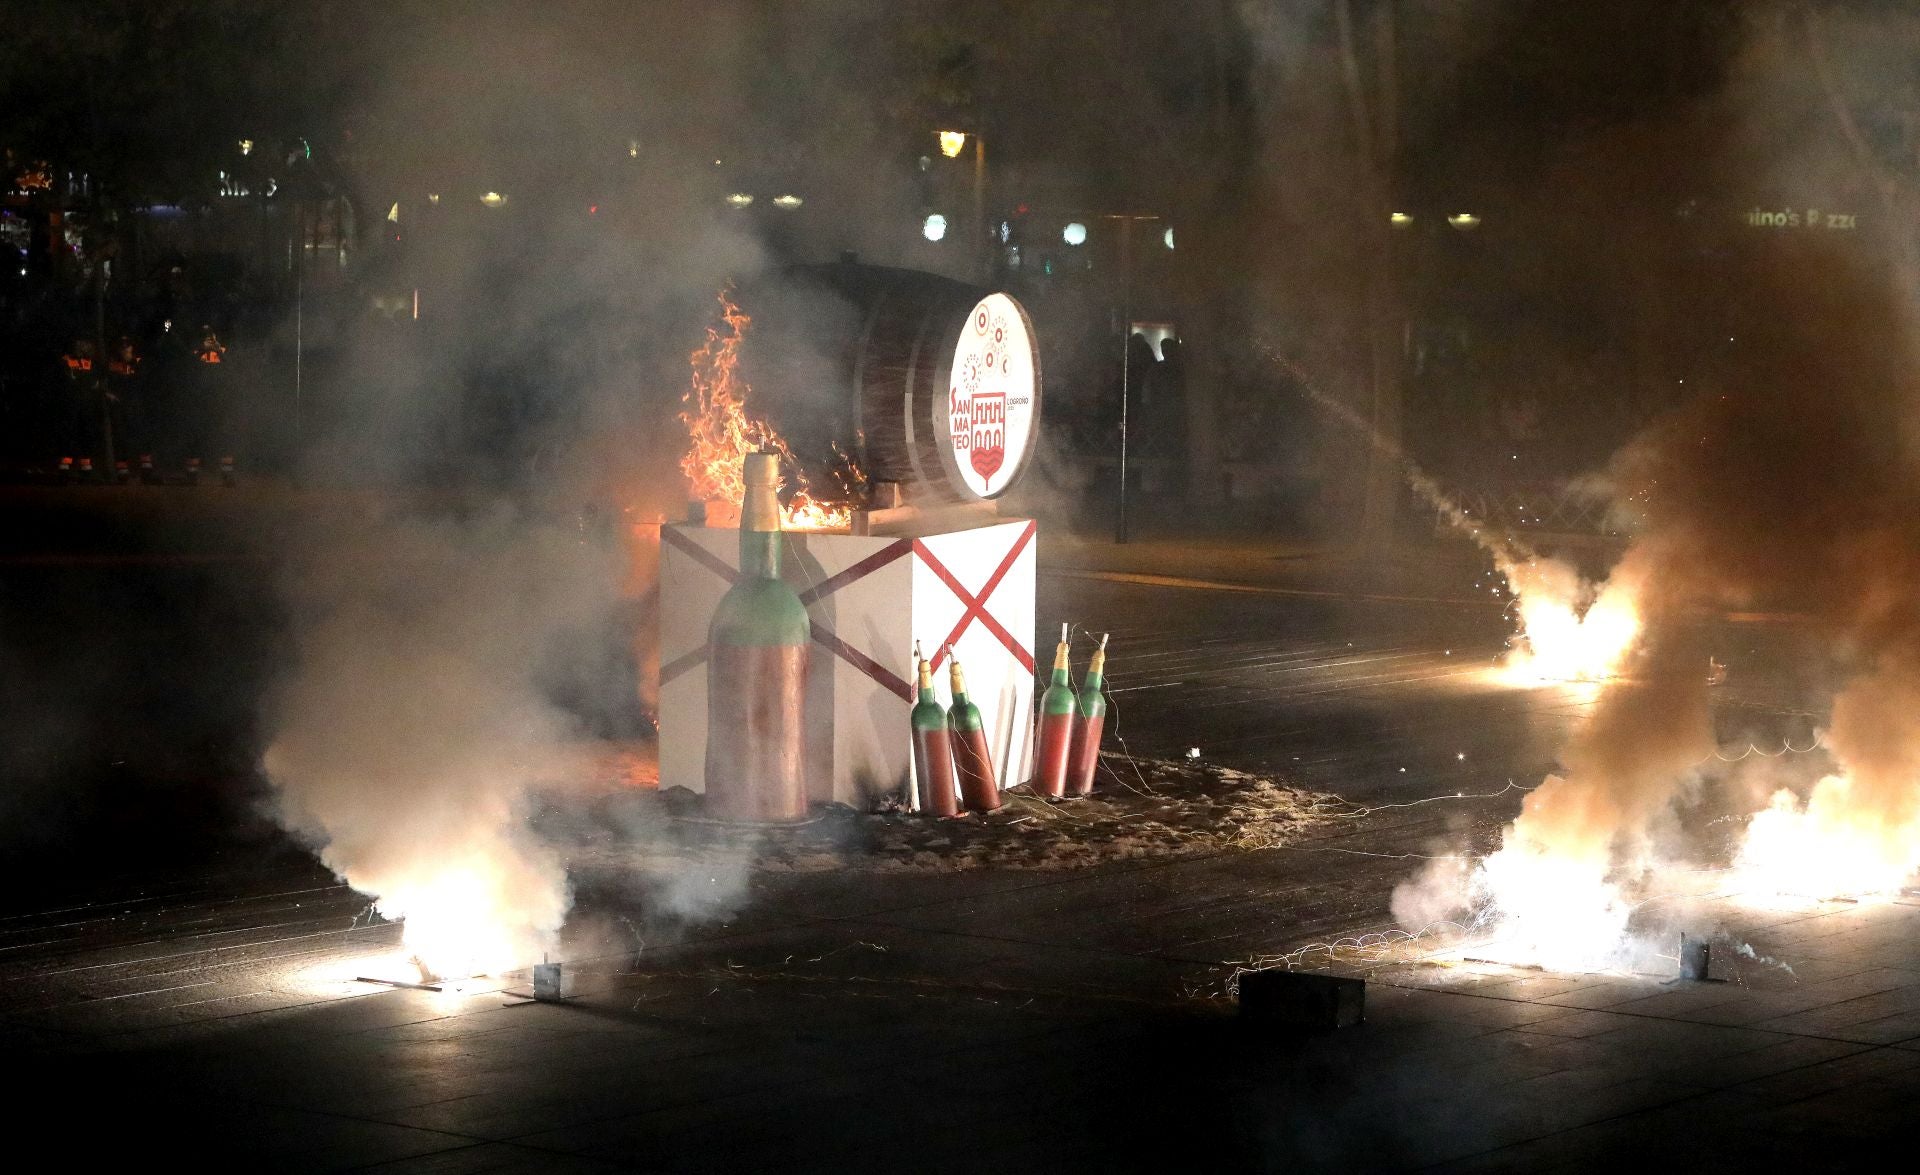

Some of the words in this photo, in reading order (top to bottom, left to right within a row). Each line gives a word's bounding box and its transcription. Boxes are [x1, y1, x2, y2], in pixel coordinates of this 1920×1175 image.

[1749, 207, 1799, 226] ino's
[1807, 208, 1855, 228] Pzz
[950, 387, 971, 415] SAN
[954, 417, 970, 432] MA
[951, 434, 970, 450] TEO
